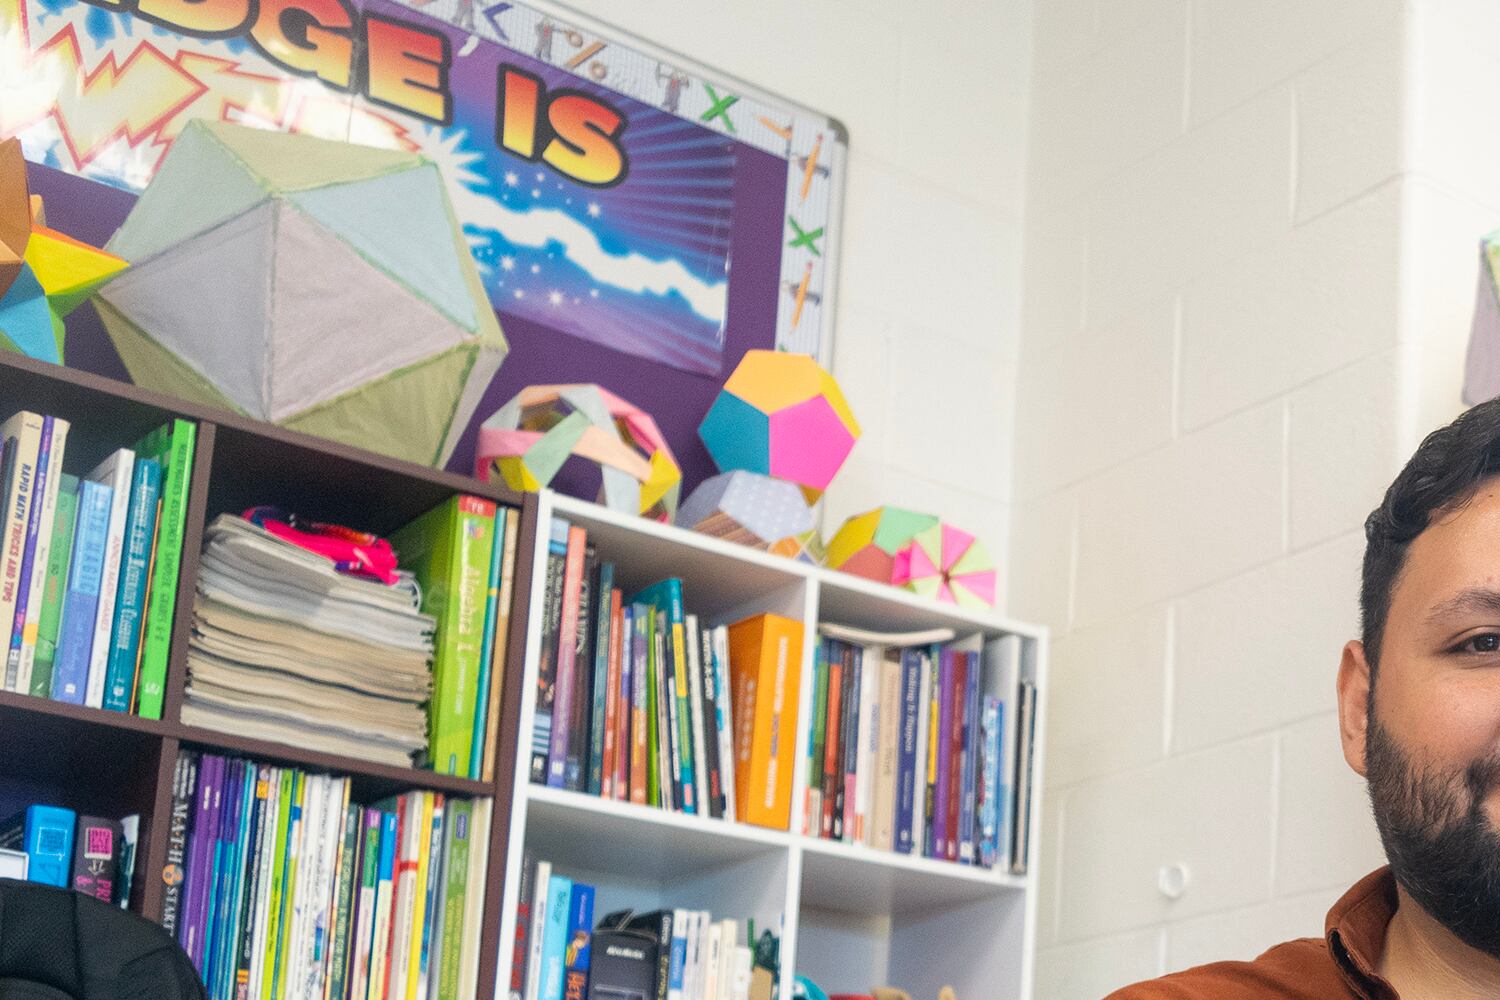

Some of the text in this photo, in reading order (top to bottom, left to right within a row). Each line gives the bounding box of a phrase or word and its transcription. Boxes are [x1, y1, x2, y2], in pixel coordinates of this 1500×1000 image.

[497, 61, 629, 187] IS
[17, 462, 31, 492] RAPID
[14, 493, 27, 520] MATH
[8, 521, 22, 556] TRICKS
[5, 558, 17, 578] AND
